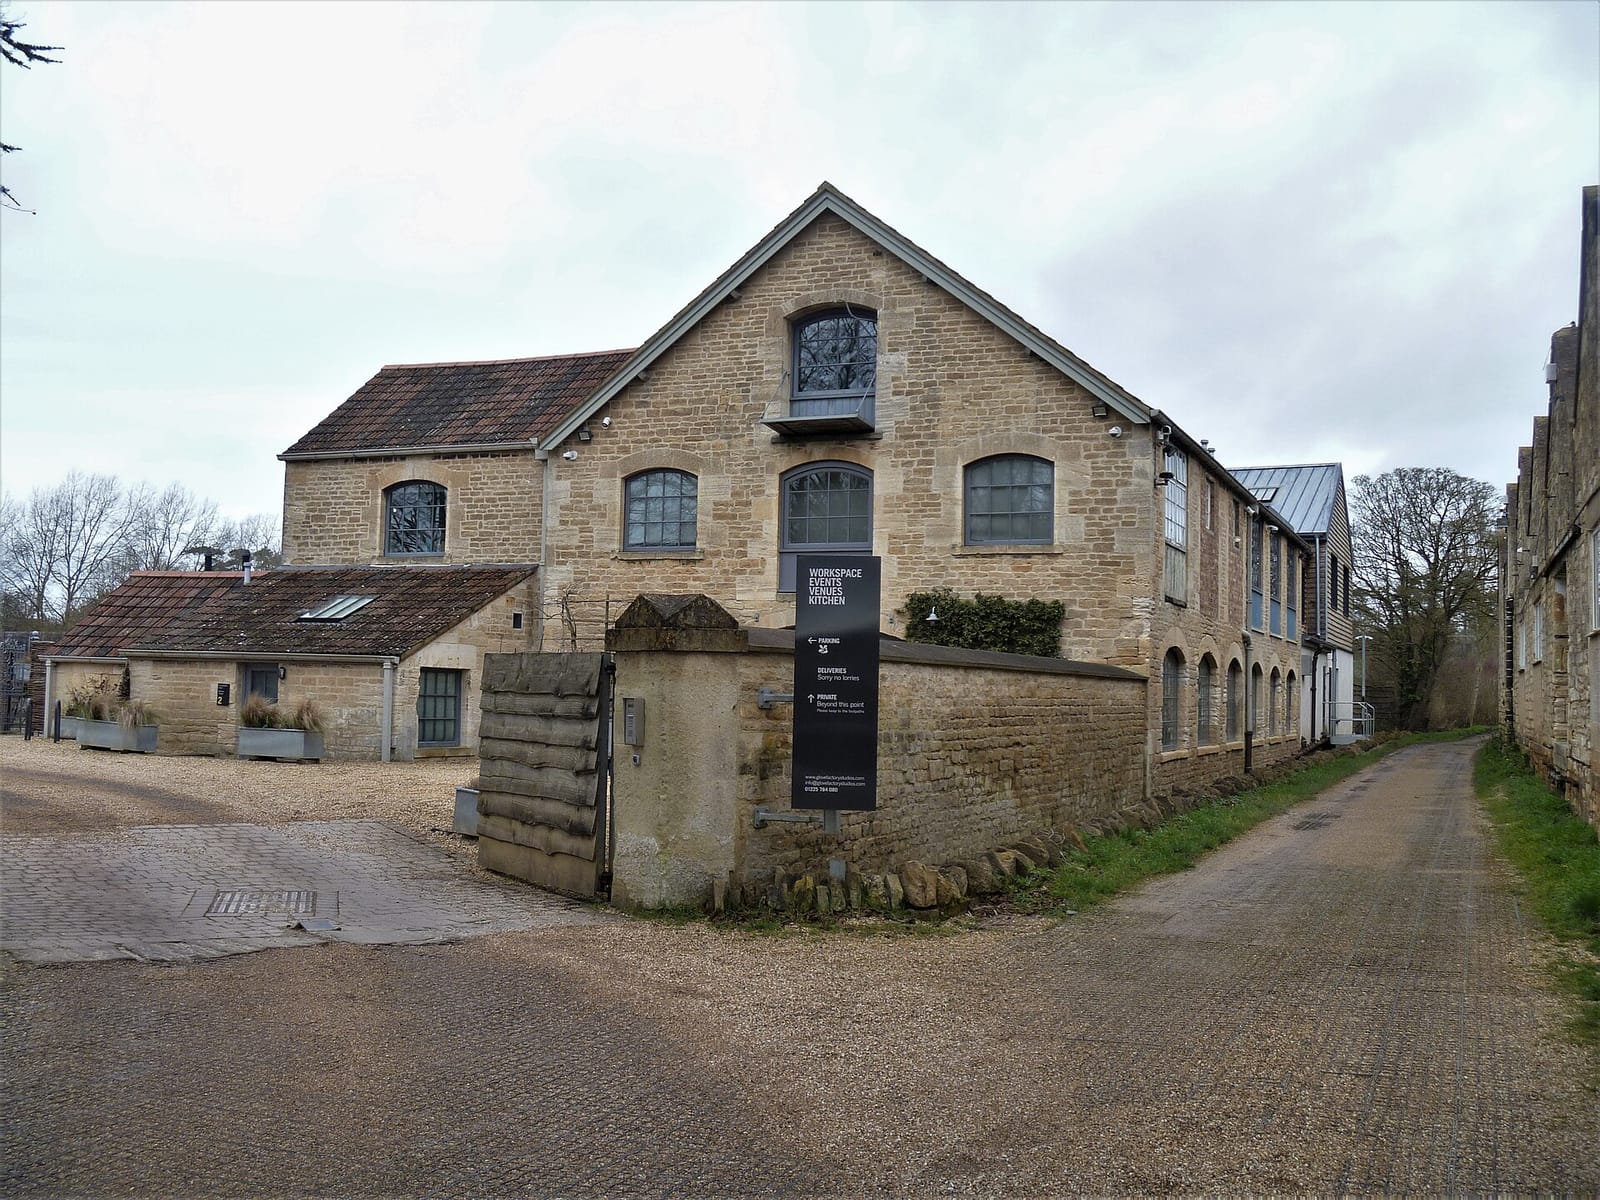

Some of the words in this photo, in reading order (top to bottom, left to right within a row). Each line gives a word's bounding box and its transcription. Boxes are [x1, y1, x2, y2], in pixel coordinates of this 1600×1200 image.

[809, 568, 862, 578] WORKSPACE
[809, 578, 842, 586] EVENTS
[808, 586, 843, 596] VENUES
[808, 596, 846, 605] KITCHEN
[817, 674, 833, 682] Sorry
[217, 696, 223, 705] 2
